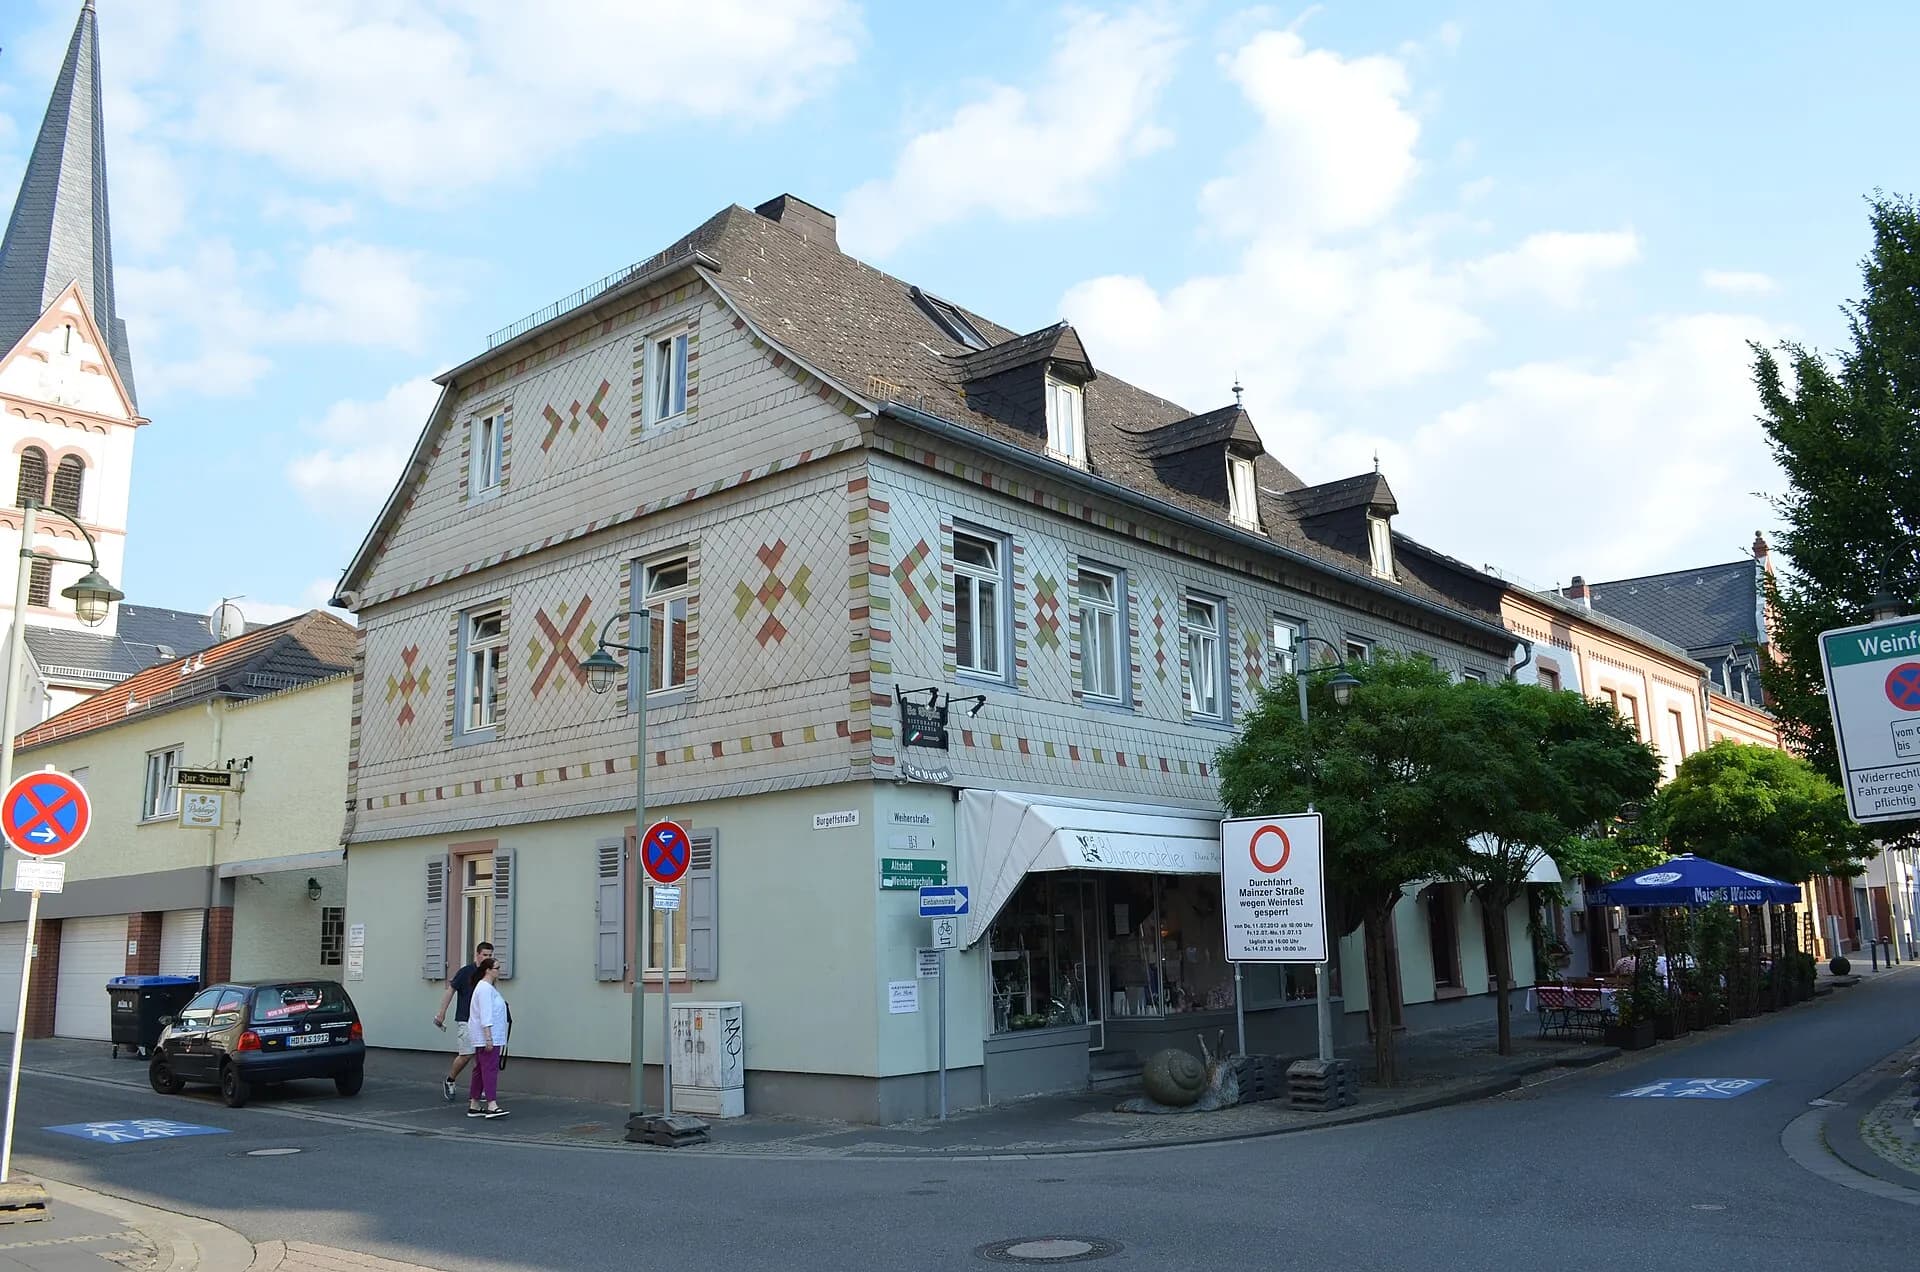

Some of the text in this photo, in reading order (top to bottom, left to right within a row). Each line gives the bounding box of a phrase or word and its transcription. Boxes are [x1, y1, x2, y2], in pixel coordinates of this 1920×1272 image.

[1857, 630, 1920, 657] Weinf
[1895, 728, 1914, 737] vom
[1897, 741, 1911, 751] bis
[907, 764, 949, 782] La Vigna
[180, 773, 228, 785] Zur Traube
[1857, 783, 1914, 798] Fahrzeuge
[1874, 796, 1916, 811] pflichtig
[893, 812, 930, 824] Weiherstraße
[890, 860, 914, 871] Altstadt
[1249, 878, 1292, 887] Durchfahrt
[1239, 887, 1305, 897] Mainzer Straße
[1730, 886, 1761, 902] Weisse
[922, 896, 956, 906] Einbahnstraße
[1239, 898, 1304, 909] wegen Weinfest
[1254, 908, 1289, 918] gesperrt
